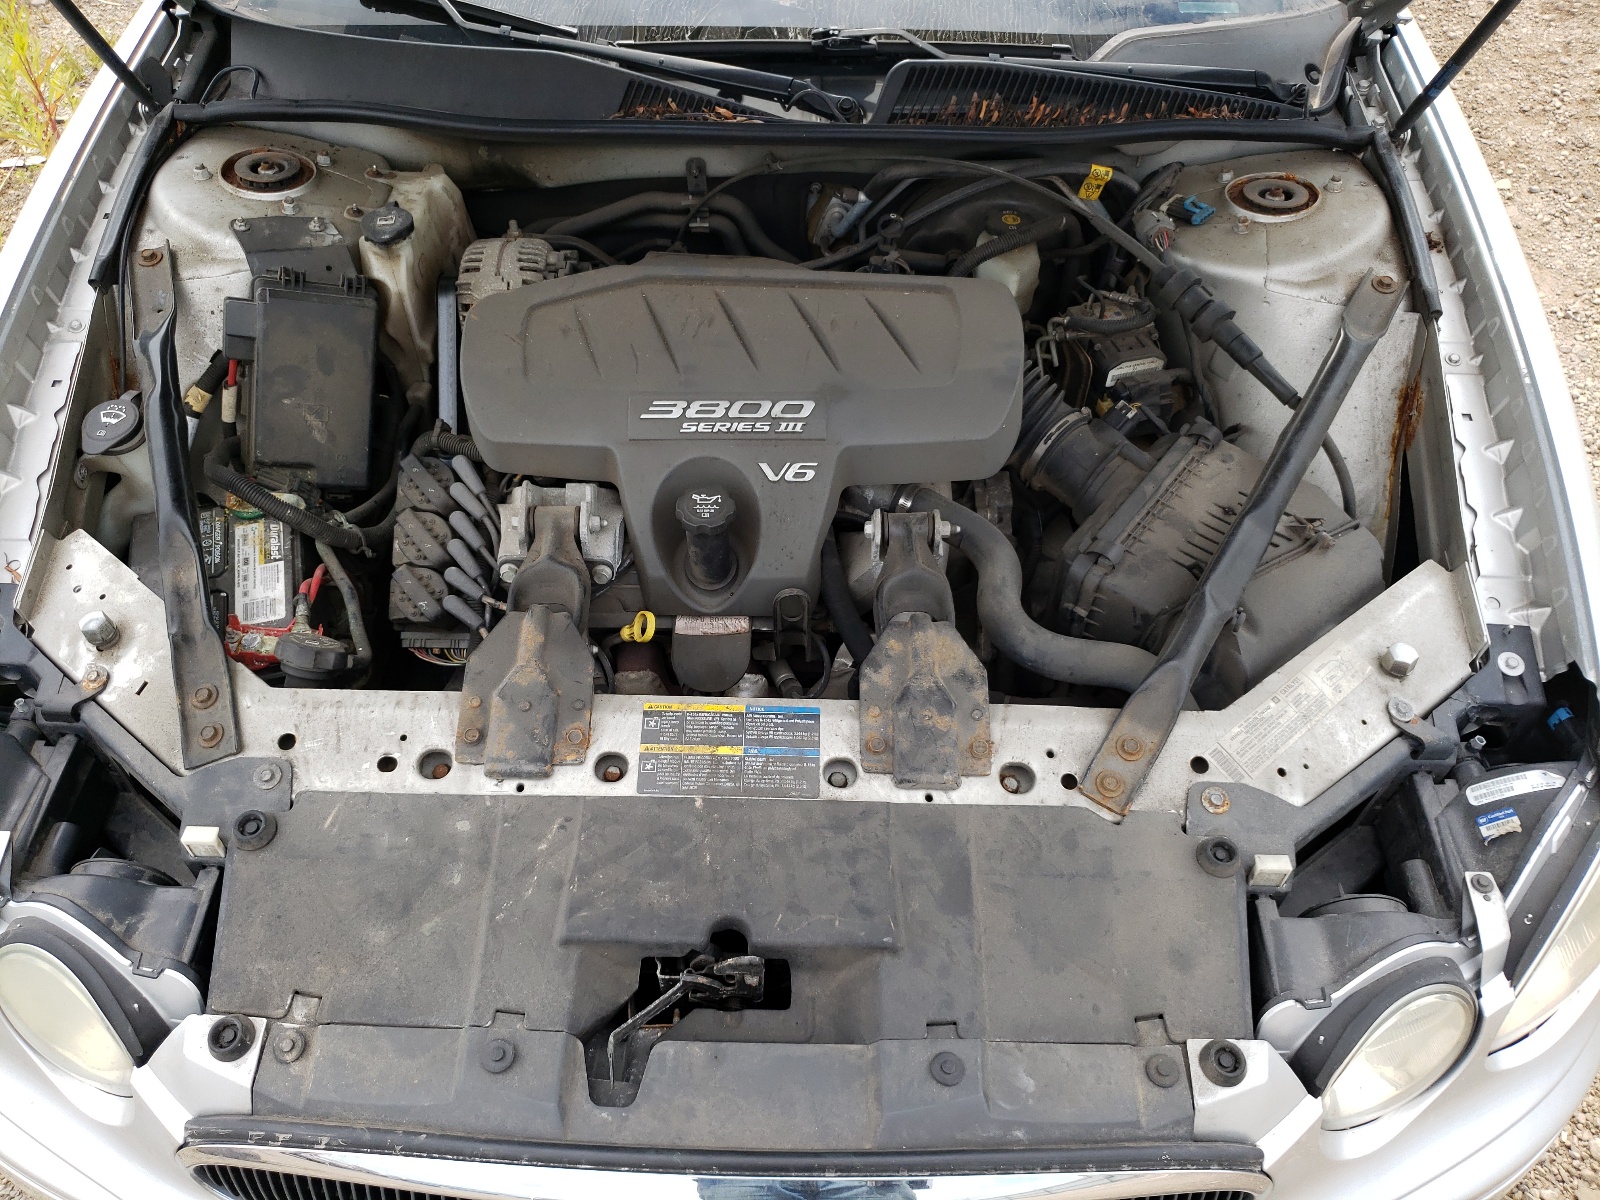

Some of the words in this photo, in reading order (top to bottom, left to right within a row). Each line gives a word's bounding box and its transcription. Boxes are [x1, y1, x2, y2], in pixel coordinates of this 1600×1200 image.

[640, 400, 816, 419] 3800
[680, 422, 771, 433] SERIES
[774, 422, 806, 432] III
[758, 462, 818, 482] V6
[268, 524, 281, 560] Duralast
